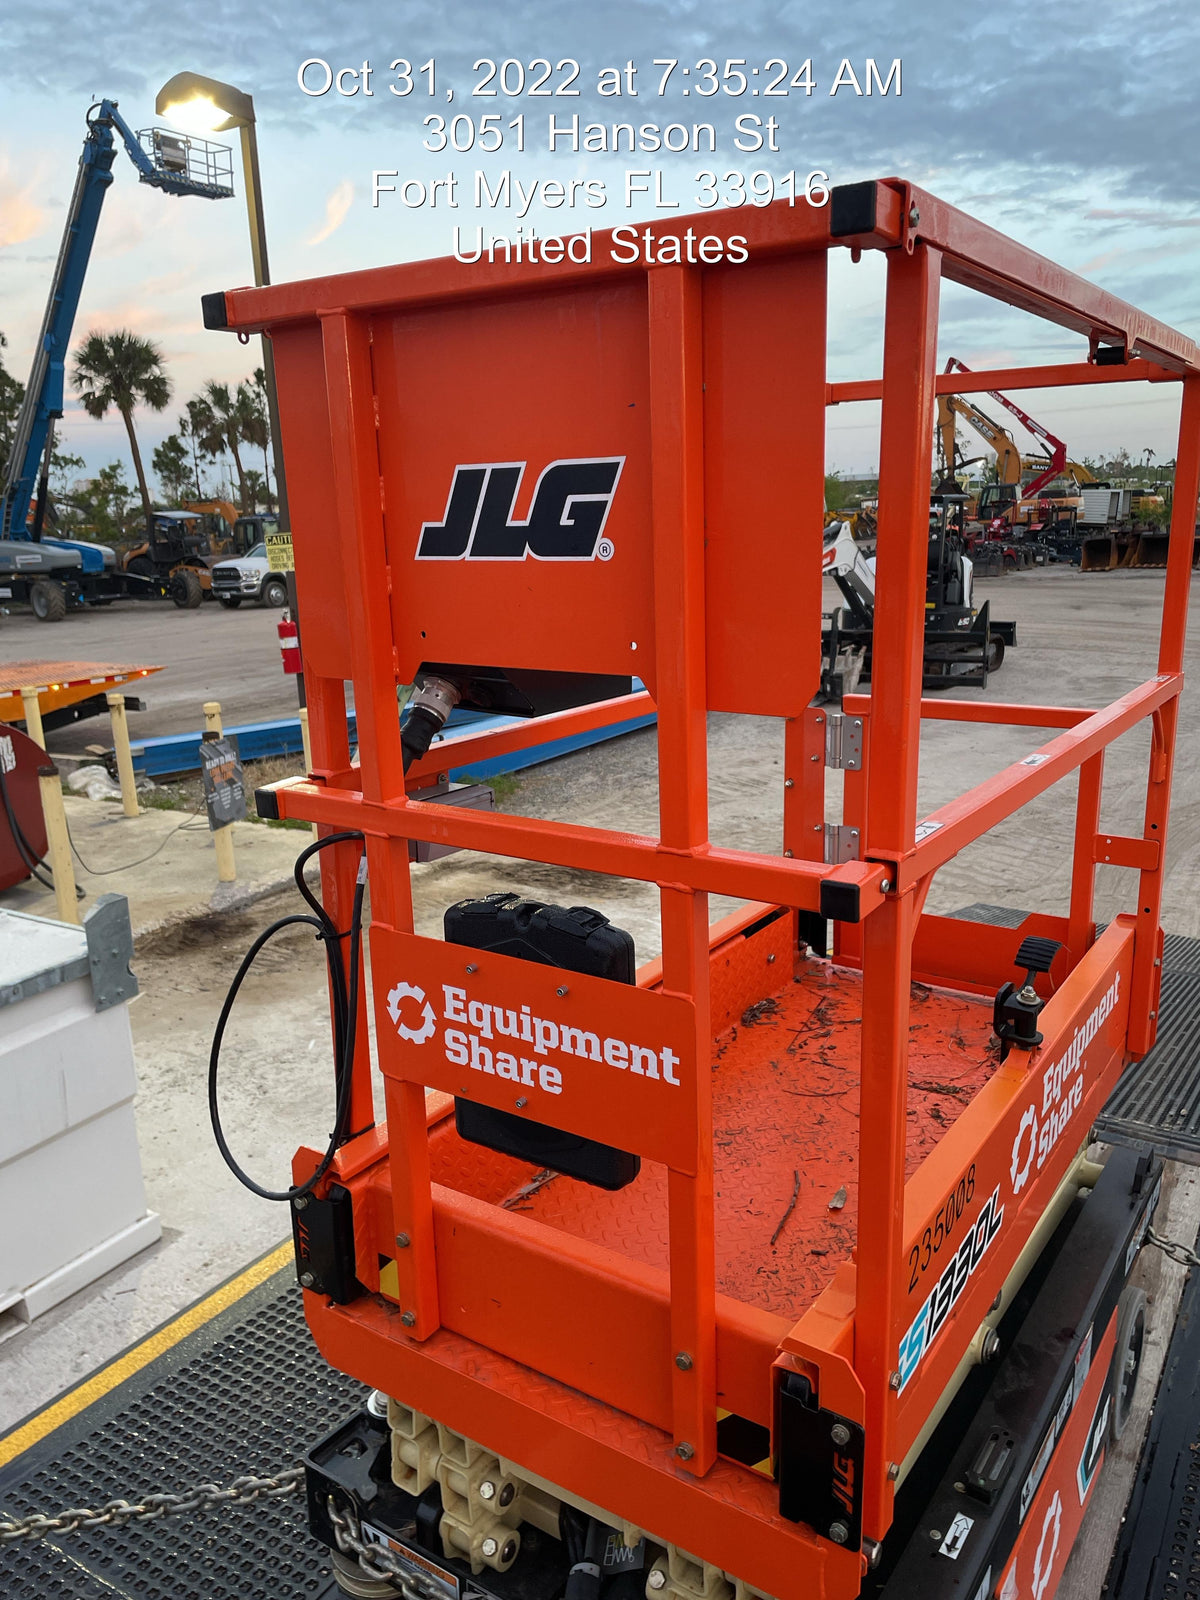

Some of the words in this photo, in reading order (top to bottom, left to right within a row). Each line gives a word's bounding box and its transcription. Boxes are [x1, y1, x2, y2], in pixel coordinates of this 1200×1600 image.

[970, 416, 995, 440] CASE
[266, 535, 293, 546] CAUTI
[414, 455, 627, 562] JLG
[442, 984, 681, 1086] Equipment
[444, 1028, 563, 1095] Share
[1041, 971, 1120, 1117] Equipment
[1037, 1073, 1083, 1170] Share
[908, 1163, 976, 1295] 235008
[832, 1450, 855, 1515] JLG
